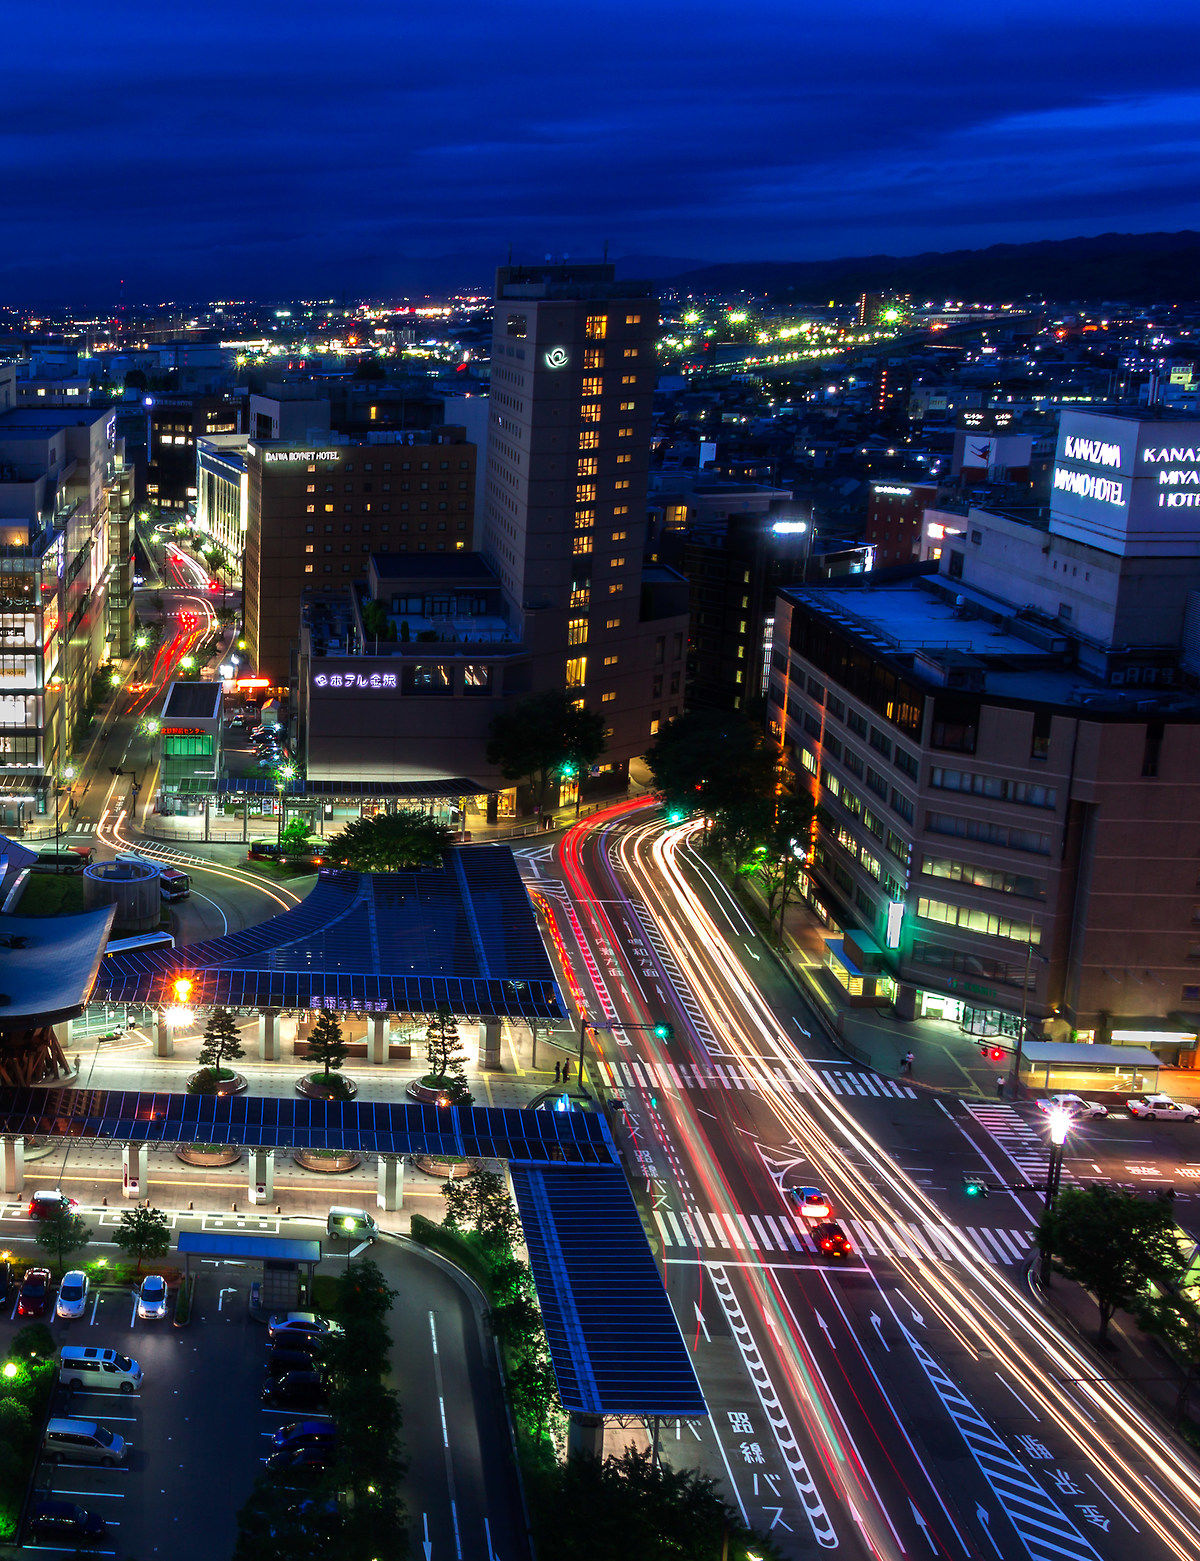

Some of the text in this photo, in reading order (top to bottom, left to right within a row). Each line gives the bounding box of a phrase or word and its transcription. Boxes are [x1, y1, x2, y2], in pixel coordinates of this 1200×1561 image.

[265, 452, 289, 461] DAIWA
[316, 451, 340, 460] HOTEL
[1064, 435, 1121, 468] KANAZAWA
[1089, 476, 1126, 506] HOTEL
[330, 674, 397, 688] ホテル金沢
[633, 1149, 673, 1210] 路線バス
[726, 1411, 795, 1533] 路線バス
[1013, 1434, 1111, 1533] 金沢駅
